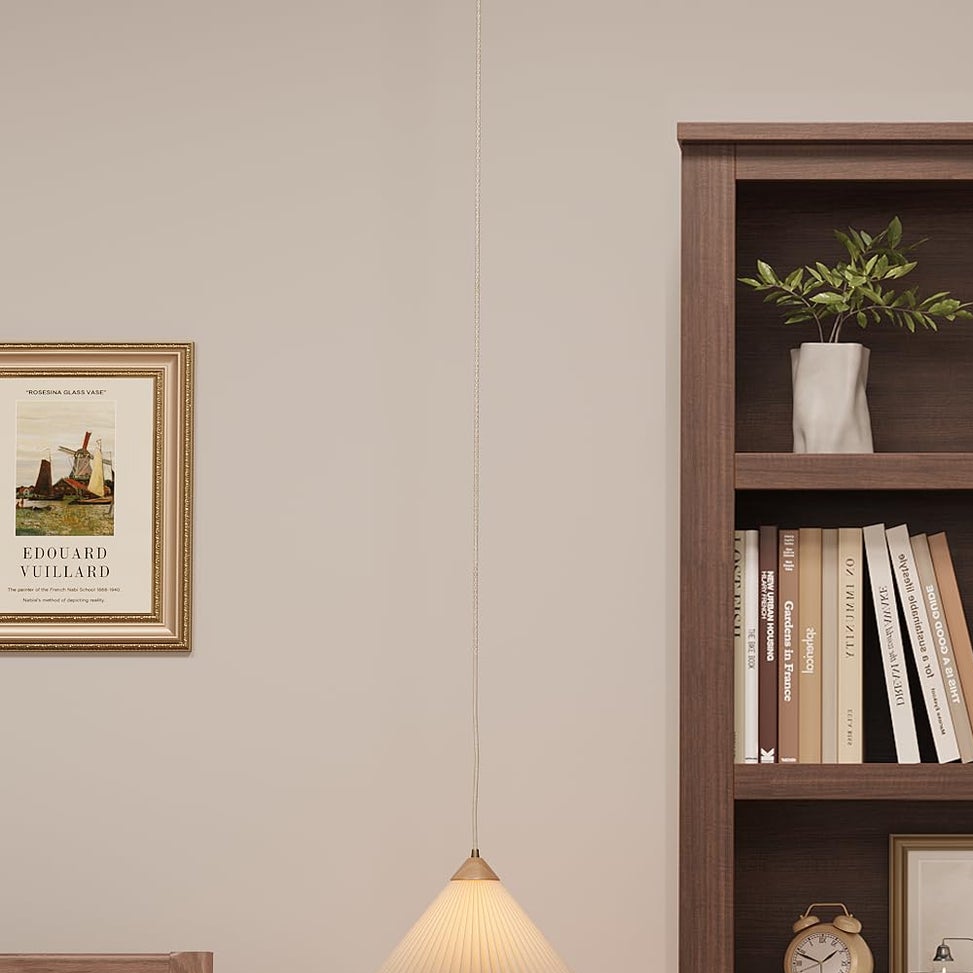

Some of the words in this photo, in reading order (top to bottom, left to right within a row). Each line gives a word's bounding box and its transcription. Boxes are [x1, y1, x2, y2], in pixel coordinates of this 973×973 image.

[23, 547, 107, 559] EDOUARD
[20, 565, 110, 578] VUILLARD
[766, 571, 774, 590] NEW
[766, 592, 774, 621] URBAN
[783, 600, 794, 647] Gardens
[748, 628, 756, 639] THE
[748, 641, 756, 654] BIKE
[766, 623, 774, 661] HOUSING
[748, 655, 756, 670] BOOK
[784, 649, 794, 661] in
[783, 664, 794, 702] France
